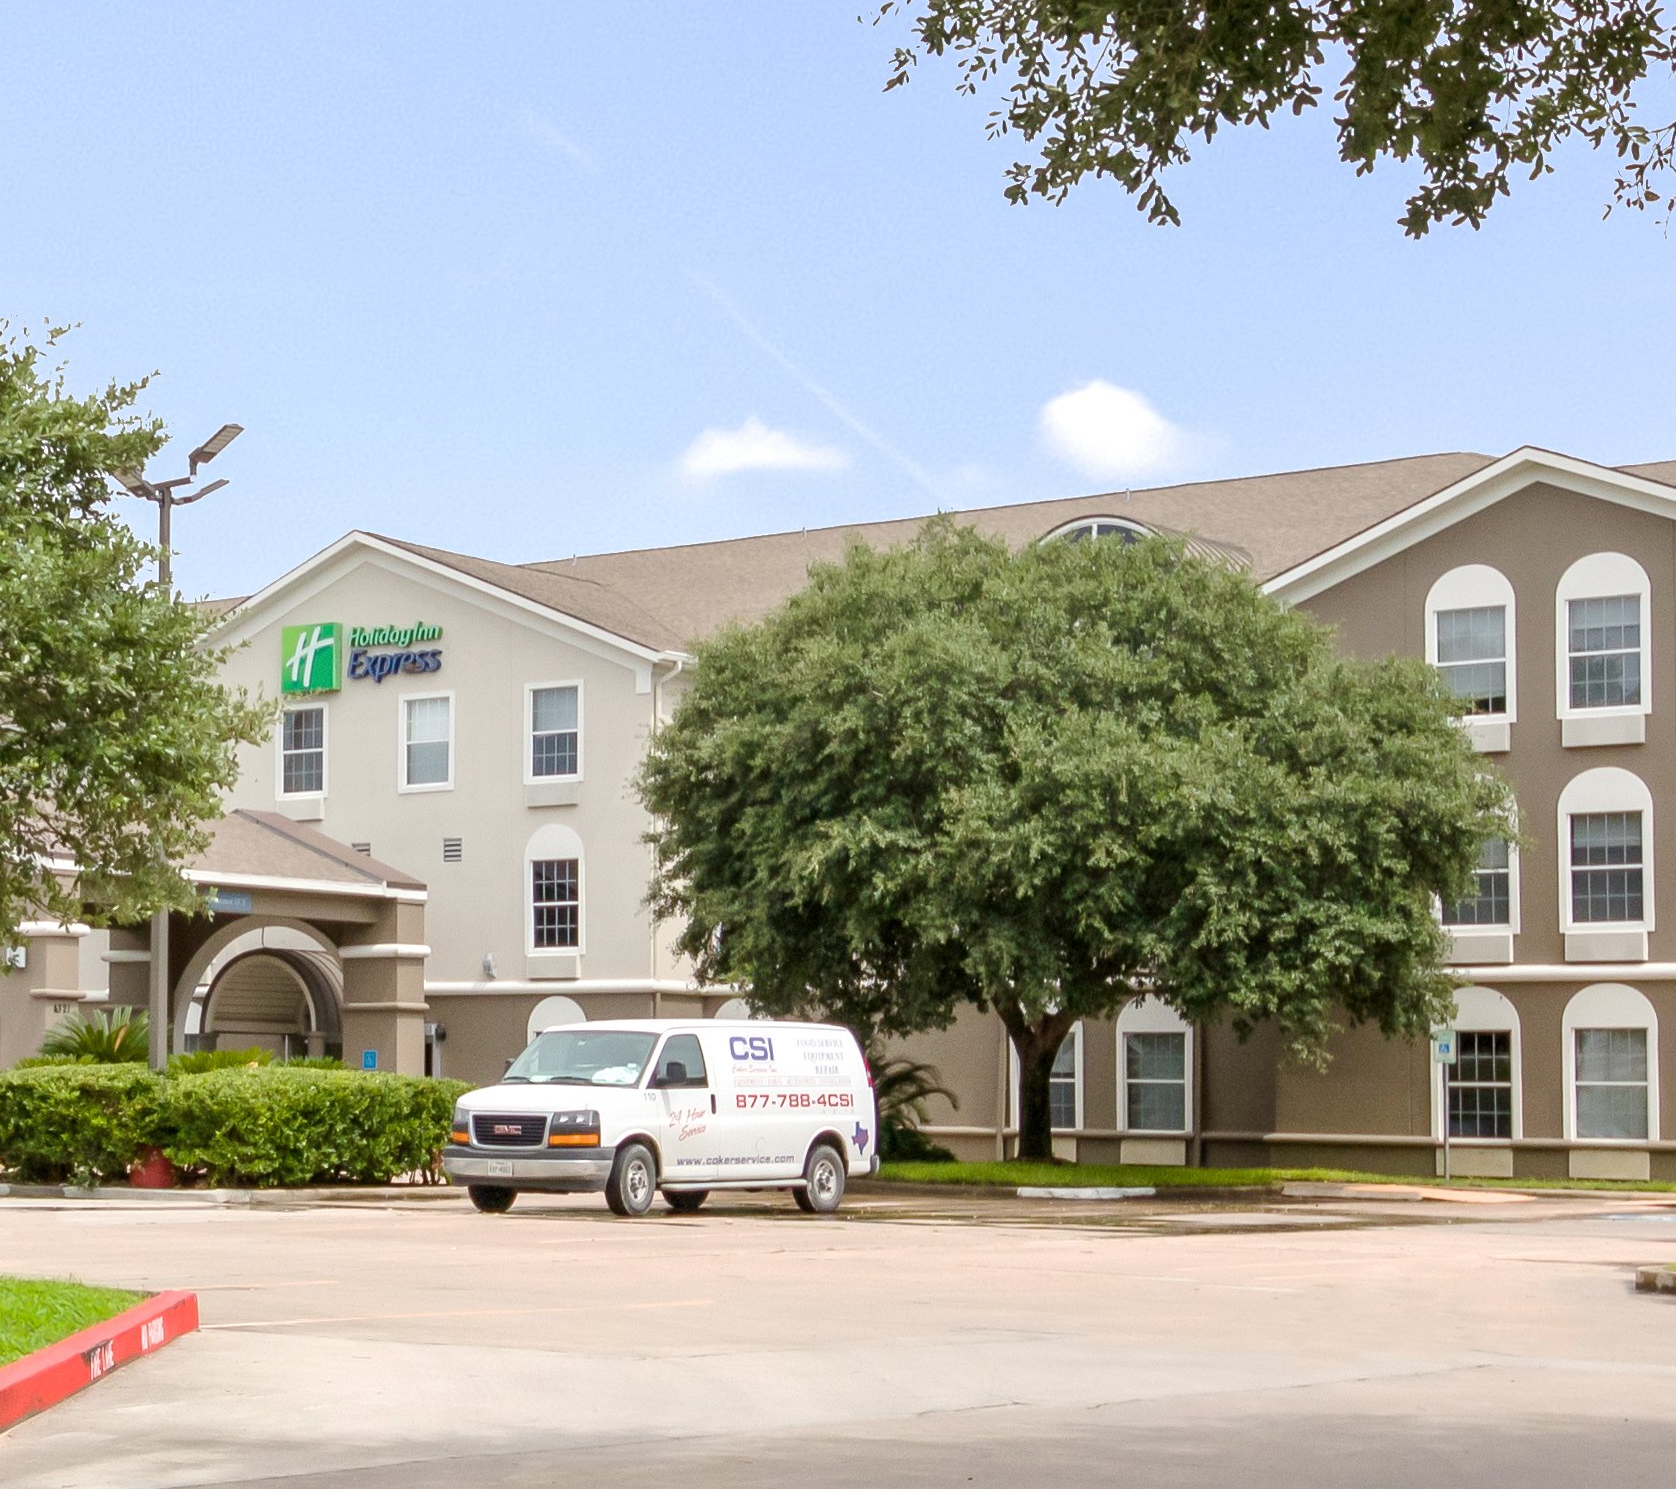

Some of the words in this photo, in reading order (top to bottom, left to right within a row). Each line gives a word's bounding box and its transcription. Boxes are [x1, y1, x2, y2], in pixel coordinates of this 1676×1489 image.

[348, 624, 412, 648] Holiday
[411, 621, 443, 642] Inn
[347, 648, 443, 683] Express
[729, 1036, 774, 1061] CSI
[736, 1093, 854, 1108] 877-788-4CSI
[676, 1154, 795, 1166] www.cokerservice.com
